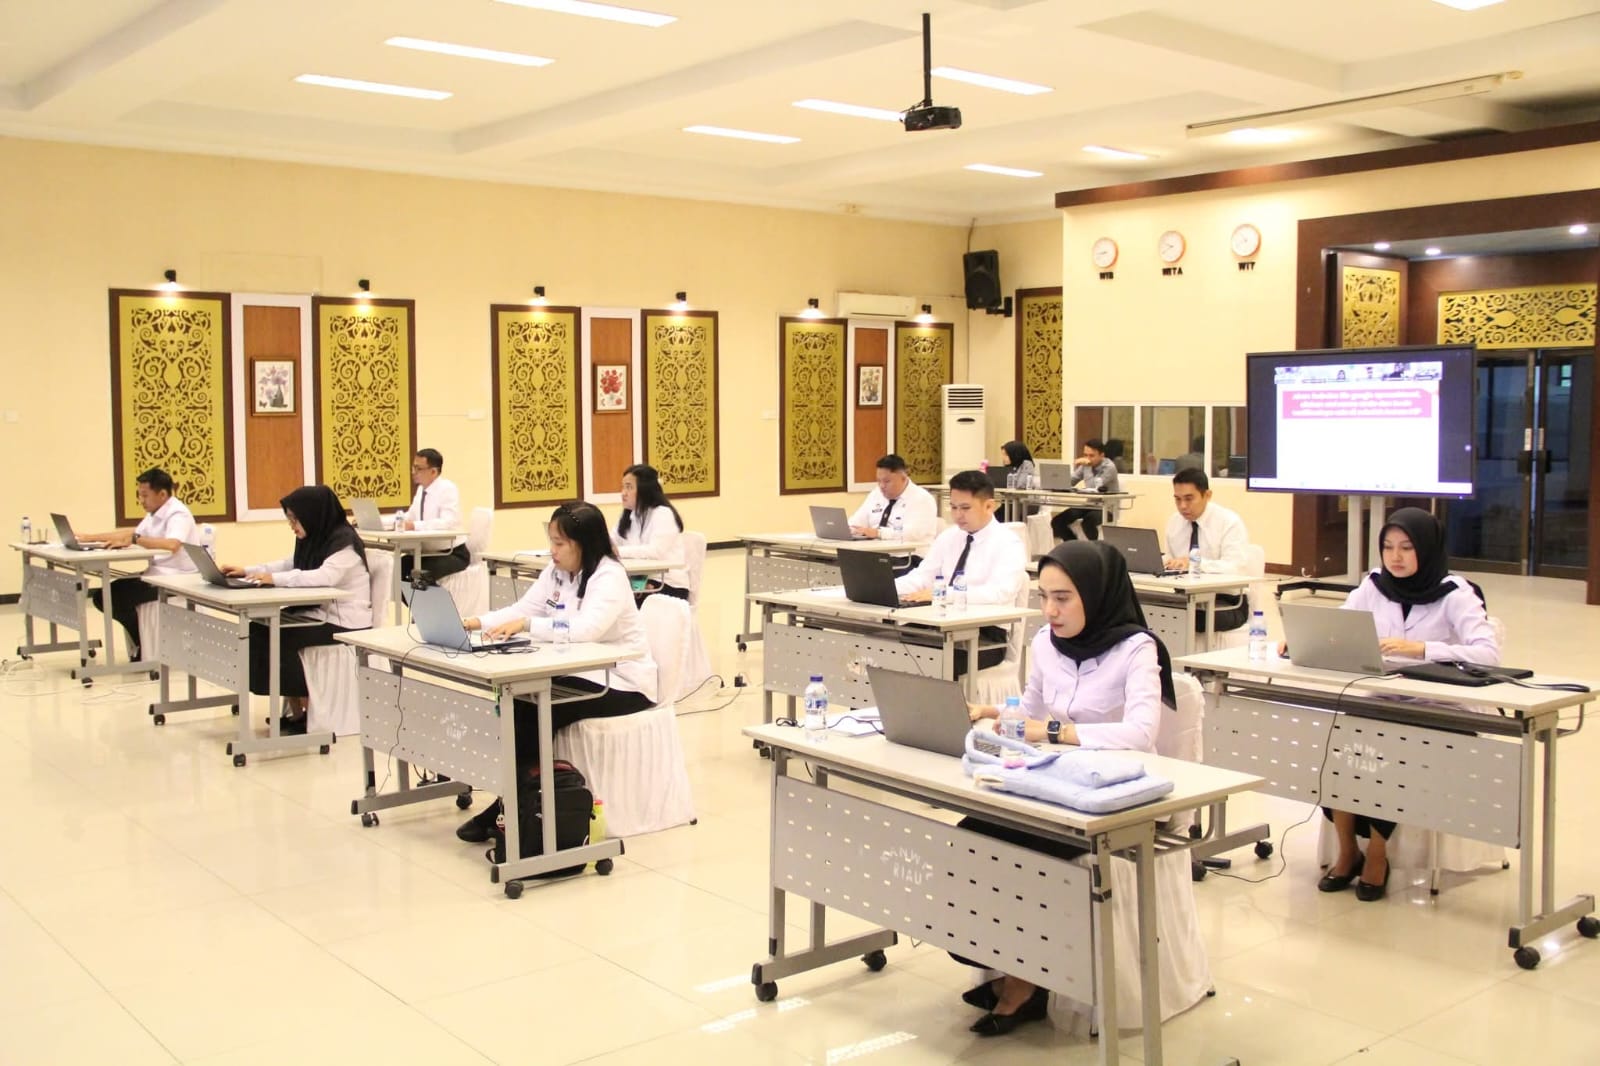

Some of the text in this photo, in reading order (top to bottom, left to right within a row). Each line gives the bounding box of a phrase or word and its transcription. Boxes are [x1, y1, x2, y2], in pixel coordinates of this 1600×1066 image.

[1162, 266, 1183, 276] WITA
[1238, 261, 1256, 271] WIT
[1099, 271, 1114, 280] WIB
[893, 861, 922, 886] RIAU
